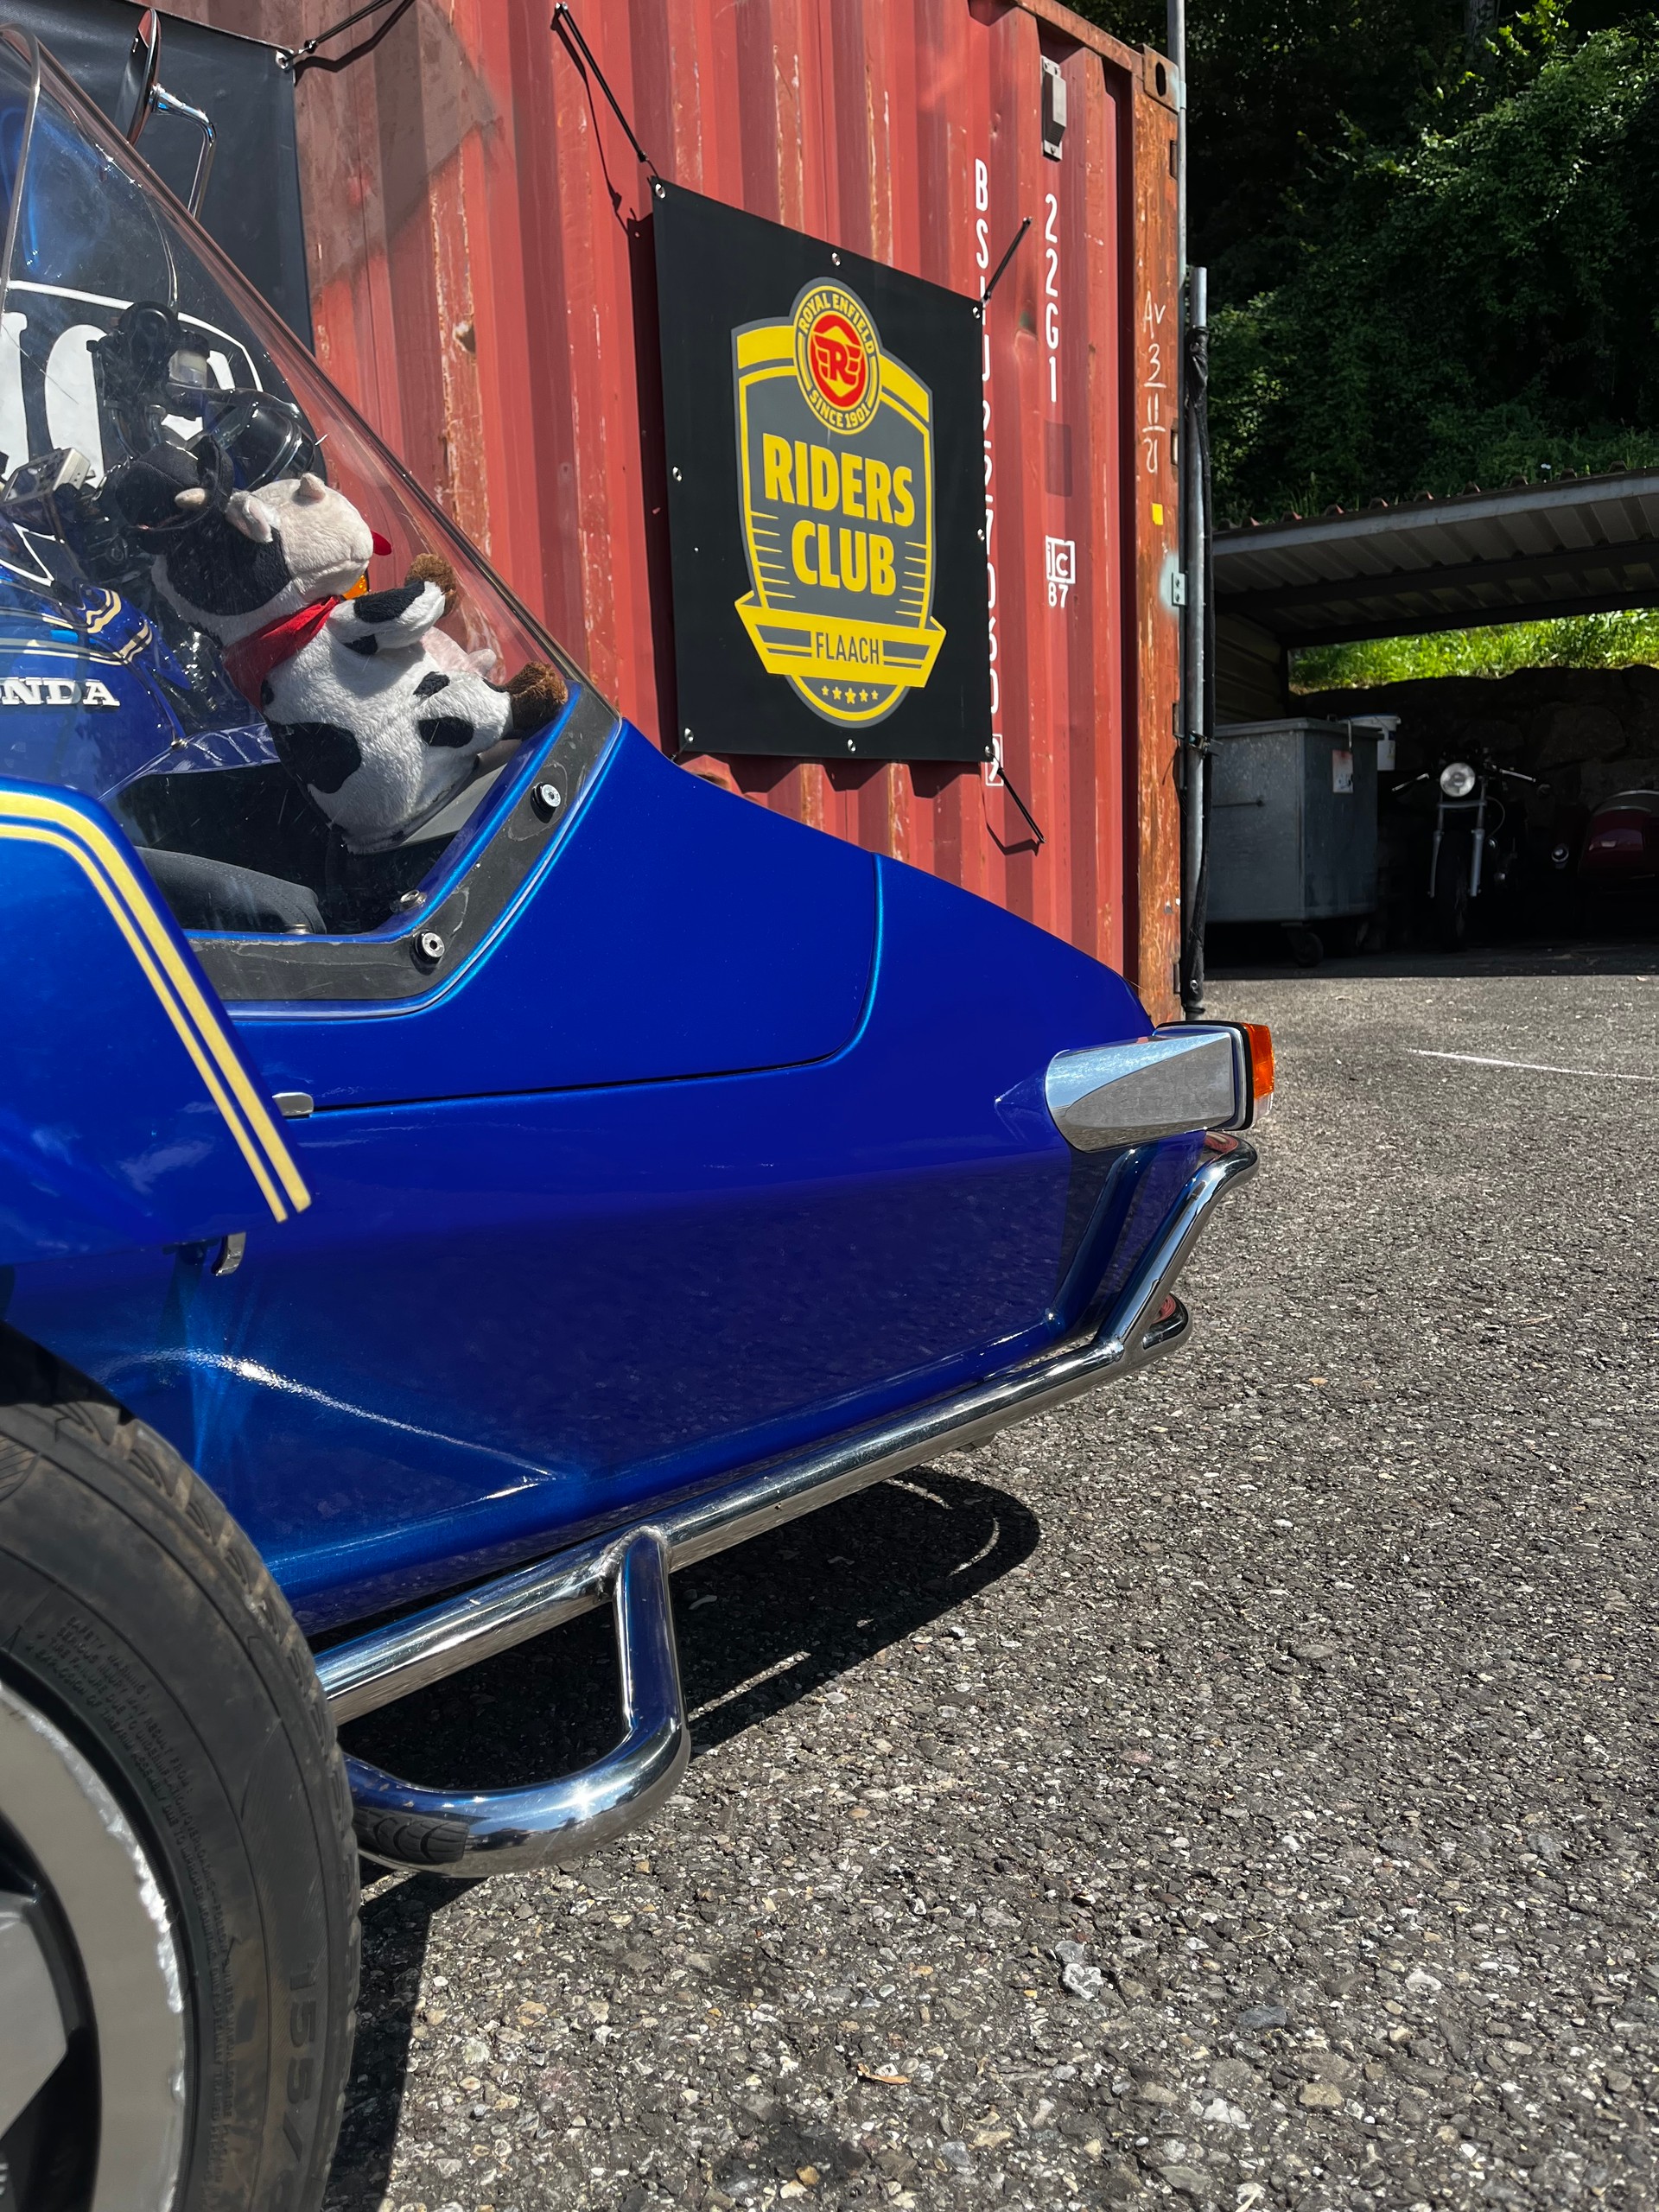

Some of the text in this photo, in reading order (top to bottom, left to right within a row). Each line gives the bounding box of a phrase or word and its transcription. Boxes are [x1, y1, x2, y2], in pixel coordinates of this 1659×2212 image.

[798, 292, 875, 354] ROYAL ENFIELD
[1045, 193, 1058, 403] 22G1
[810, 390, 871, 429] SINCE 1901
[762, 433, 916, 527] RIDERS
[791, 519, 897, 596] CLUB
[1048, 582, 1069, 608] 87
[815, 632, 880, 665] FLAACH
[0, 677, 120, 707] NDA
